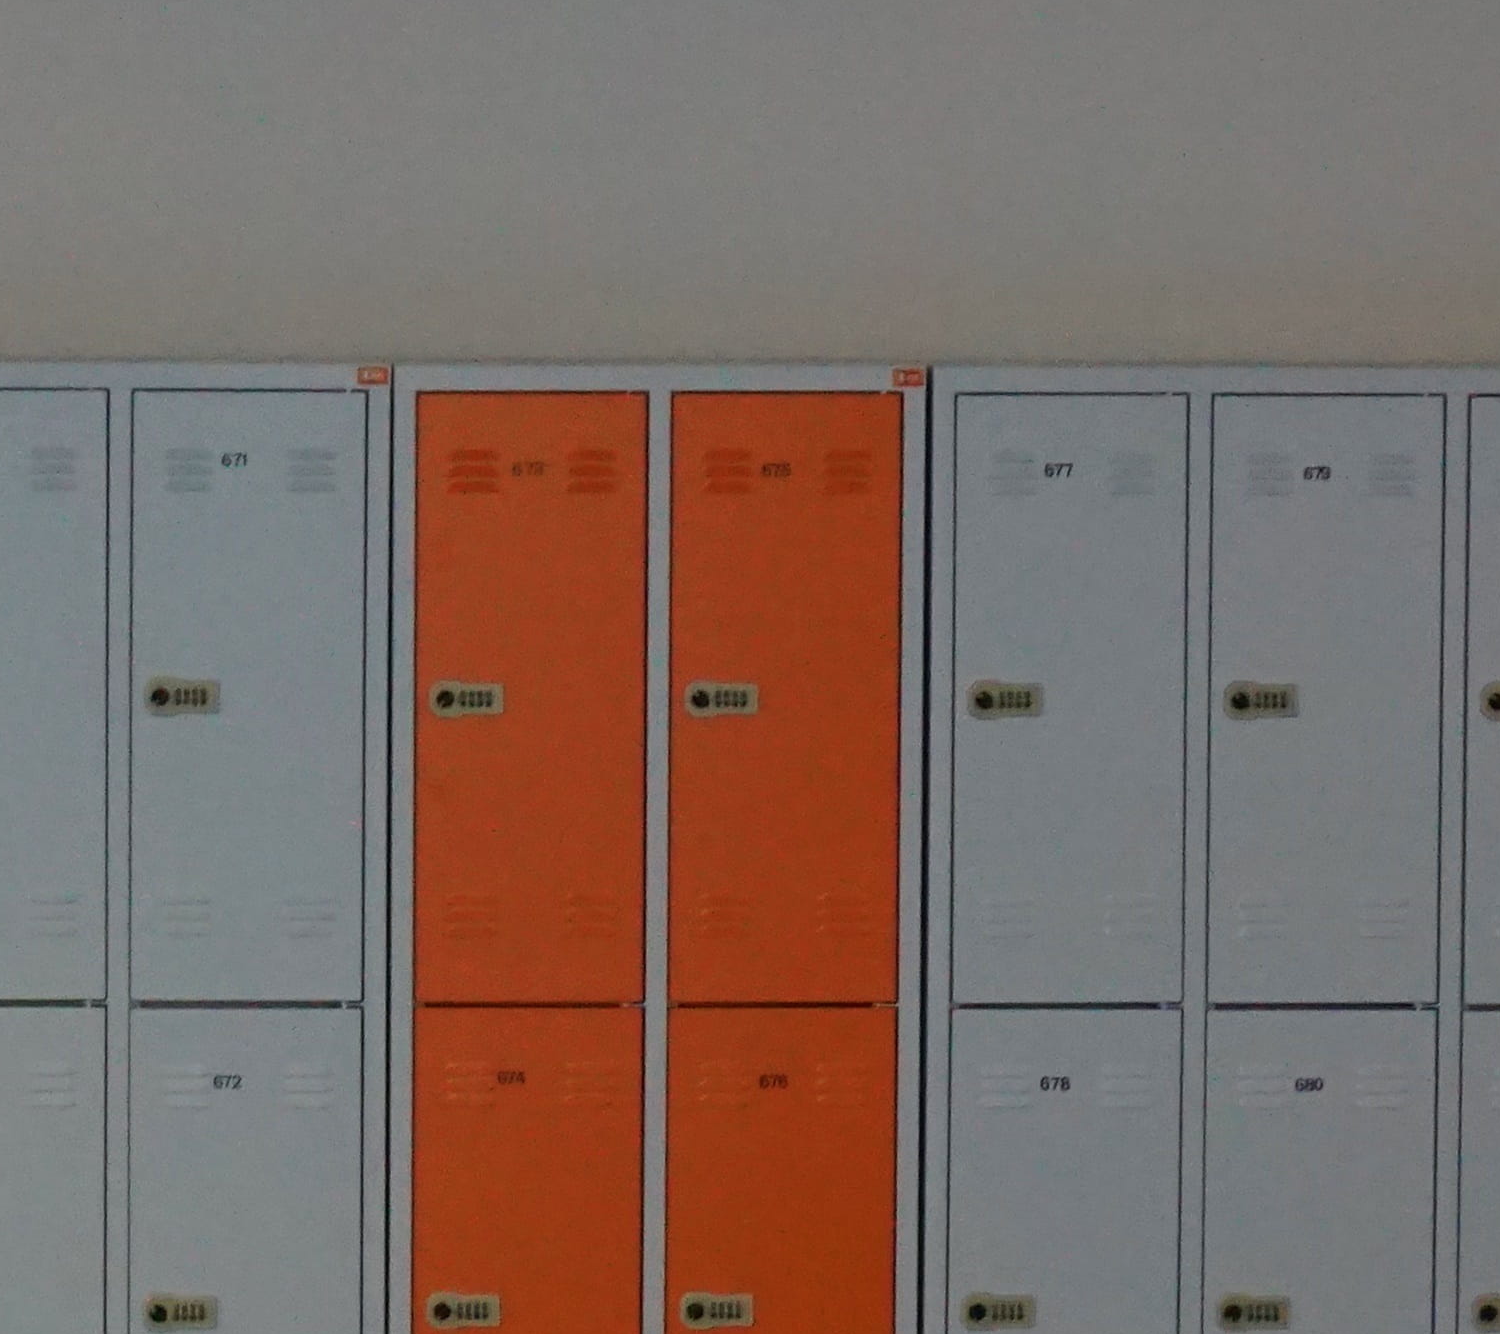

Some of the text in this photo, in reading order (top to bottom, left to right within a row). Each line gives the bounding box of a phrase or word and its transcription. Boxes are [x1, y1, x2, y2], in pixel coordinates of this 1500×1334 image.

[220, 452, 249, 468] 671
[1043, 462, 1074, 478] 677
[212, 1074, 243, 1090] 672
[1039, 1075, 1072, 1092] 678
[1294, 1077, 1325, 1093] 680
